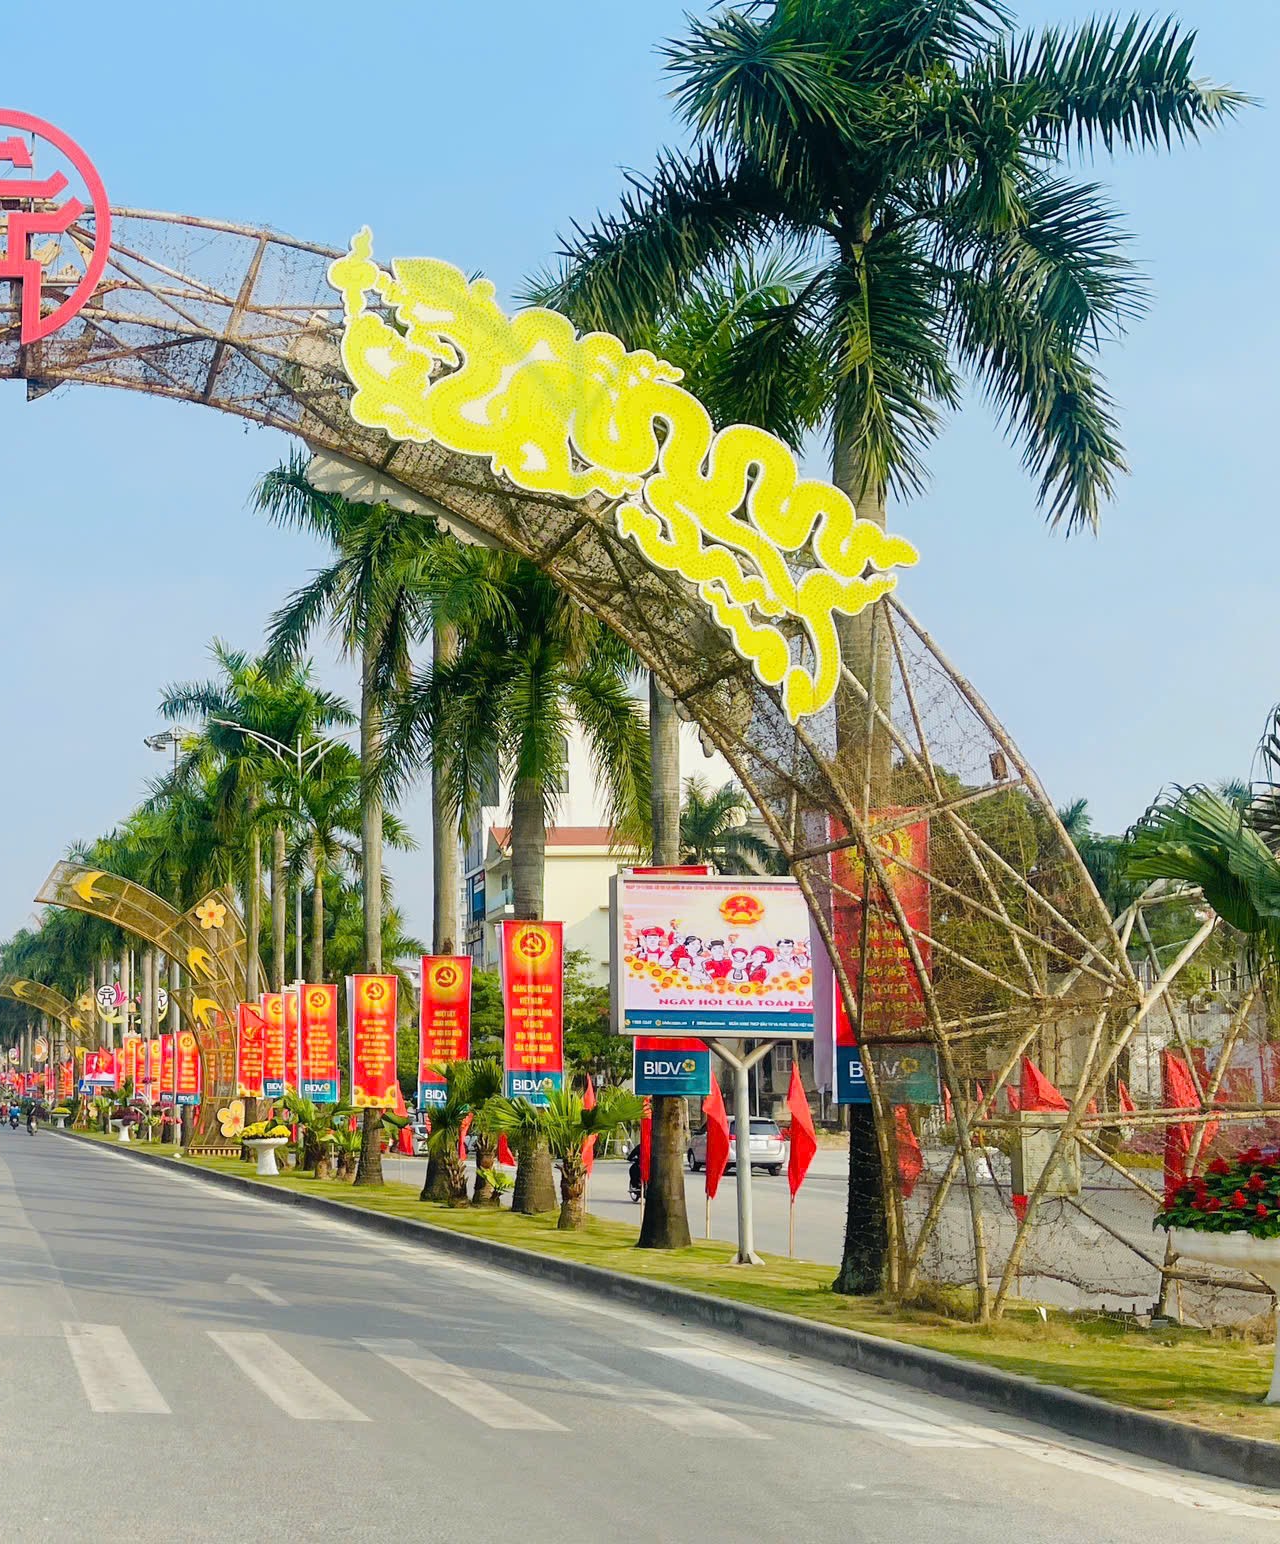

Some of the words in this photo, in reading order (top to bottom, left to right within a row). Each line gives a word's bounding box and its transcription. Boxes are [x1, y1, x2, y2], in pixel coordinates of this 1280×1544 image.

[643, 1061, 683, 1075] BIDV
[304, 1084, 324, 1092] BIDV
[513, 1079, 543, 1091] BIDV
